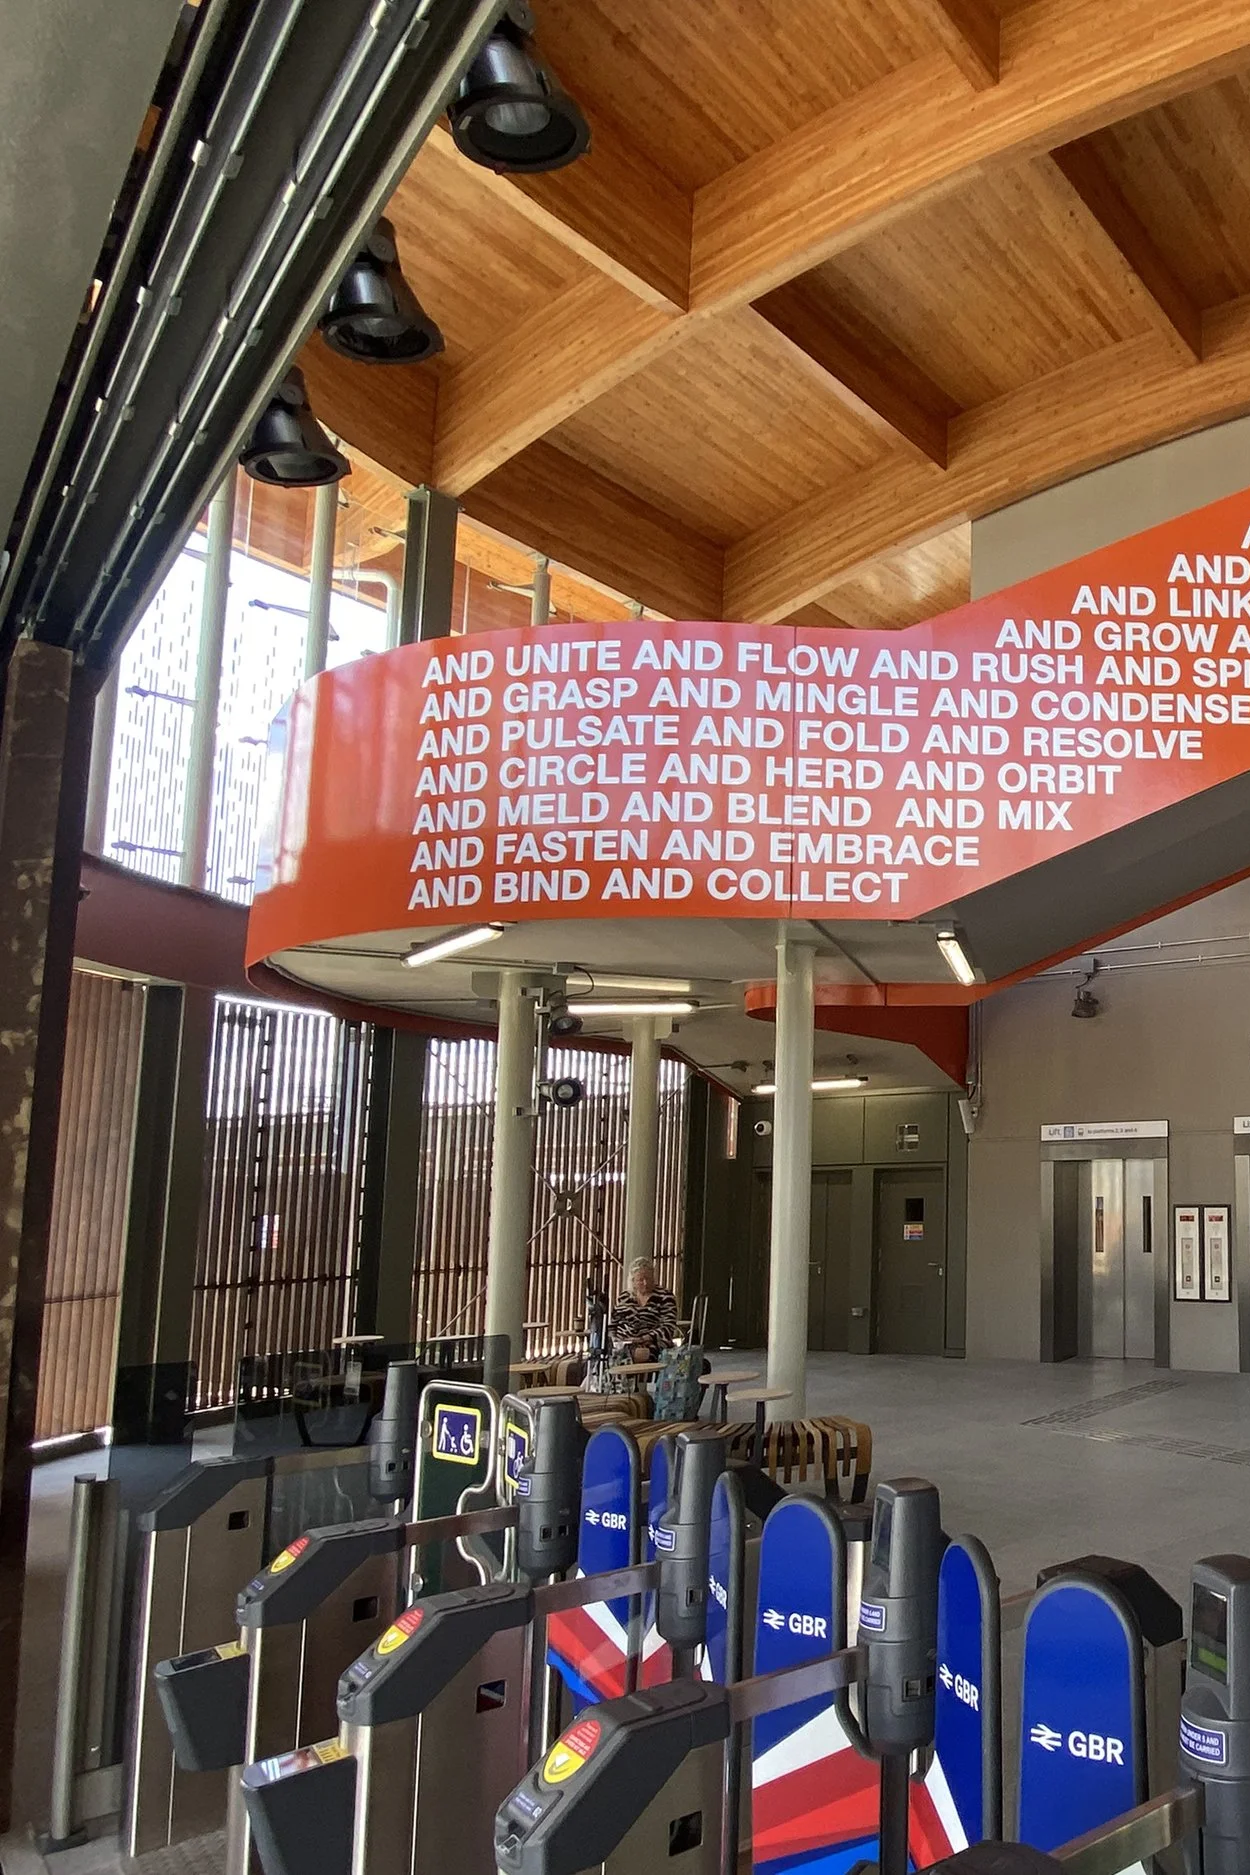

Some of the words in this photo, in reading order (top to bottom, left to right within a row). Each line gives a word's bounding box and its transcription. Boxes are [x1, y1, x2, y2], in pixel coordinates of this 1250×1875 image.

[1070, 585, 1156, 616] AND
[994, 618, 1082, 650] AND
[1093, 620, 1219, 653] GROW
[421, 649, 495, 689] AND
[505, 639, 622, 677] UNITE
[631, 639, 724, 672] AND
[737, 641, 860, 678] FLOW
[869, 648, 959, 681] AND
[972, 651, 1084, 685] RUSH
[1095, 655, 1181, 687] AND
[418, 686, 493, 725] AND
[502, 677, 639, 714] GRASP
[648, 676, 742, 709] AND
[755, 679, 920, 717] MINGLE
[929, 687, 1019, 720] AND
[416, 723, 491, 762] AND
[501, 714, 680, 752] PULSATE
[690, 715, 785, 749] AND
[798, 719, 910, 754] FOLD
[921, 723, 1010, 756] AND
[1023, 726, 1203, 760] RESOLVE
[414, 760, 489, 798] AND
[498, 752, 647, 790] CIRCLE
[657, 752, 752, 786] AND
[765, 755, 885, 791] HERD
[894, 759, 986, 793] AND
[996, 761, 1123, 796] ORBIT
[412, 798, 487, 835] AND
[497, 791, 610, 827] MELD
[620, 790, 714, 823] AND
[727, 791, 872, 828] BLEND
[894, 796, 986, 830] AND
[997, 799, 1074, 832] MIX
[410, 836, 484, 873] AND
[496, 828, 649, 865] FASTEN
[660, 828, 756, 862] AND
[769, 831, 981, 867] EMBRACE
[407, 874, 482, 910] AND
[494, 869, 590, 903] BIND
[601, 867, 693, 900] AND
[706, 867, 909, 904] COLLECT
[1048, 1128, 1061, 1136] Lift
[601, 1511, 627, 1530] GBR
[788, 1612, 827, 1638] GBR
[954, 1674, 980, 1712] GBR
[1068, 1729, 1125, 1766] GBR
